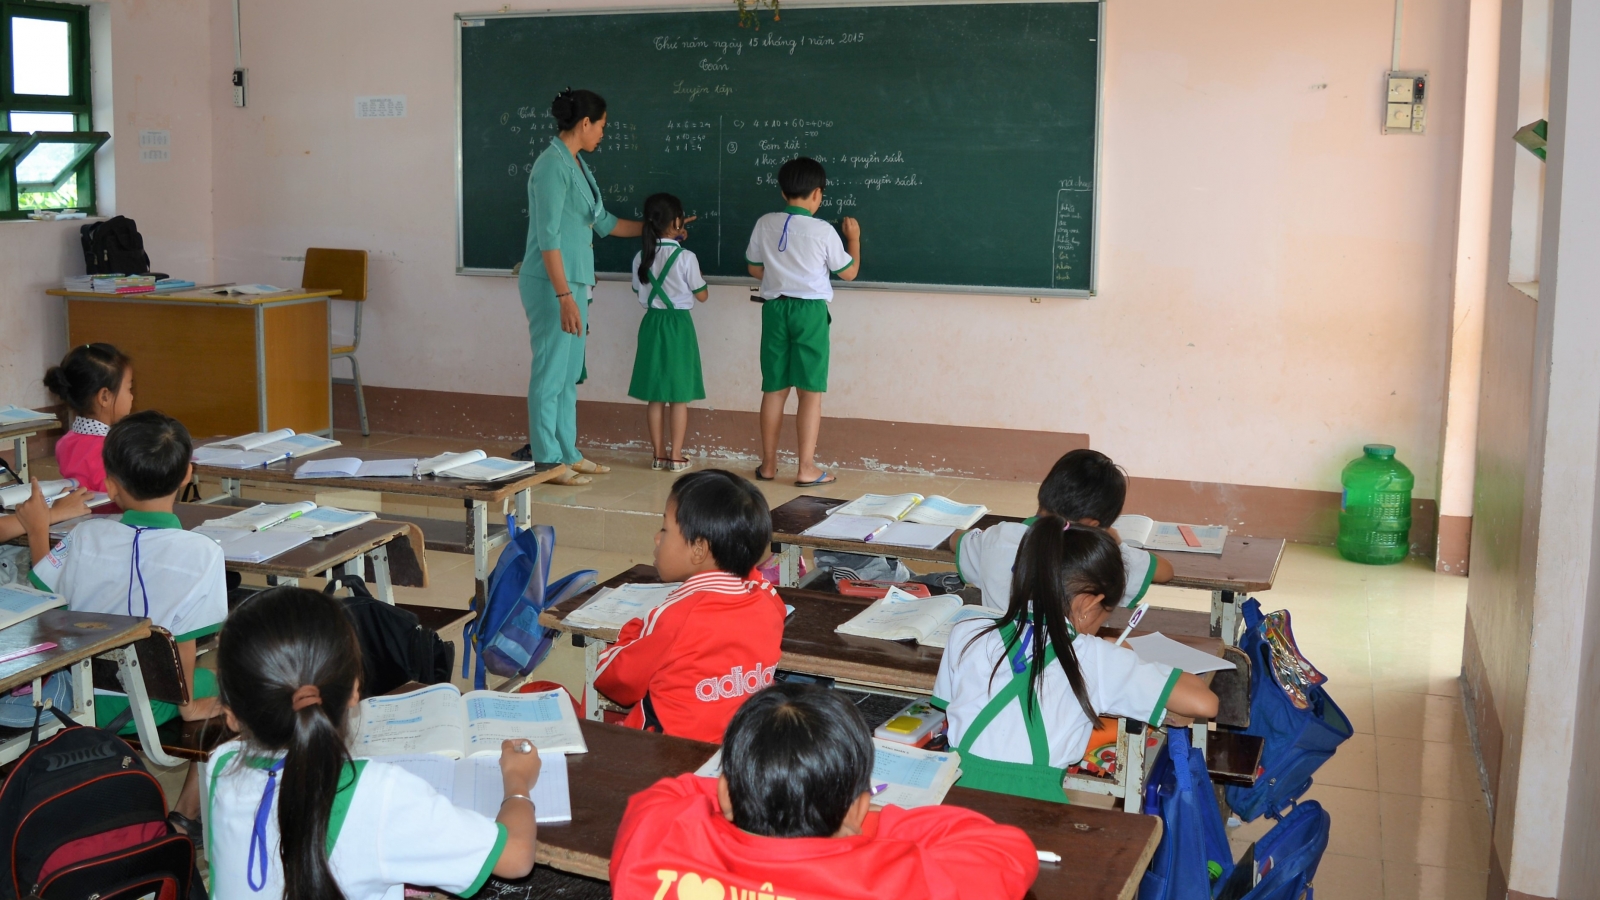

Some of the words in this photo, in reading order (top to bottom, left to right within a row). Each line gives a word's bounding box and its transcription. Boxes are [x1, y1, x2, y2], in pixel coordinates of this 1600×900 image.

[653, 36, 681, 51] Thứ
[682, 37, 709, 48] năm
[713, 38, 743, 55] ngày
[748, 37, 759, 47] 15
[762, 32, 797, 55] tháng
[808, 35, 835, 46] năm
[839, 32, 865, 44] 2015
[699, 57, 729, 71] Toán
[753, 119, 759, 128] 4
[840, 154, 847, 163] 4
[756, 176, 763, 186] 5
[765, 172, 779, 188] họ
